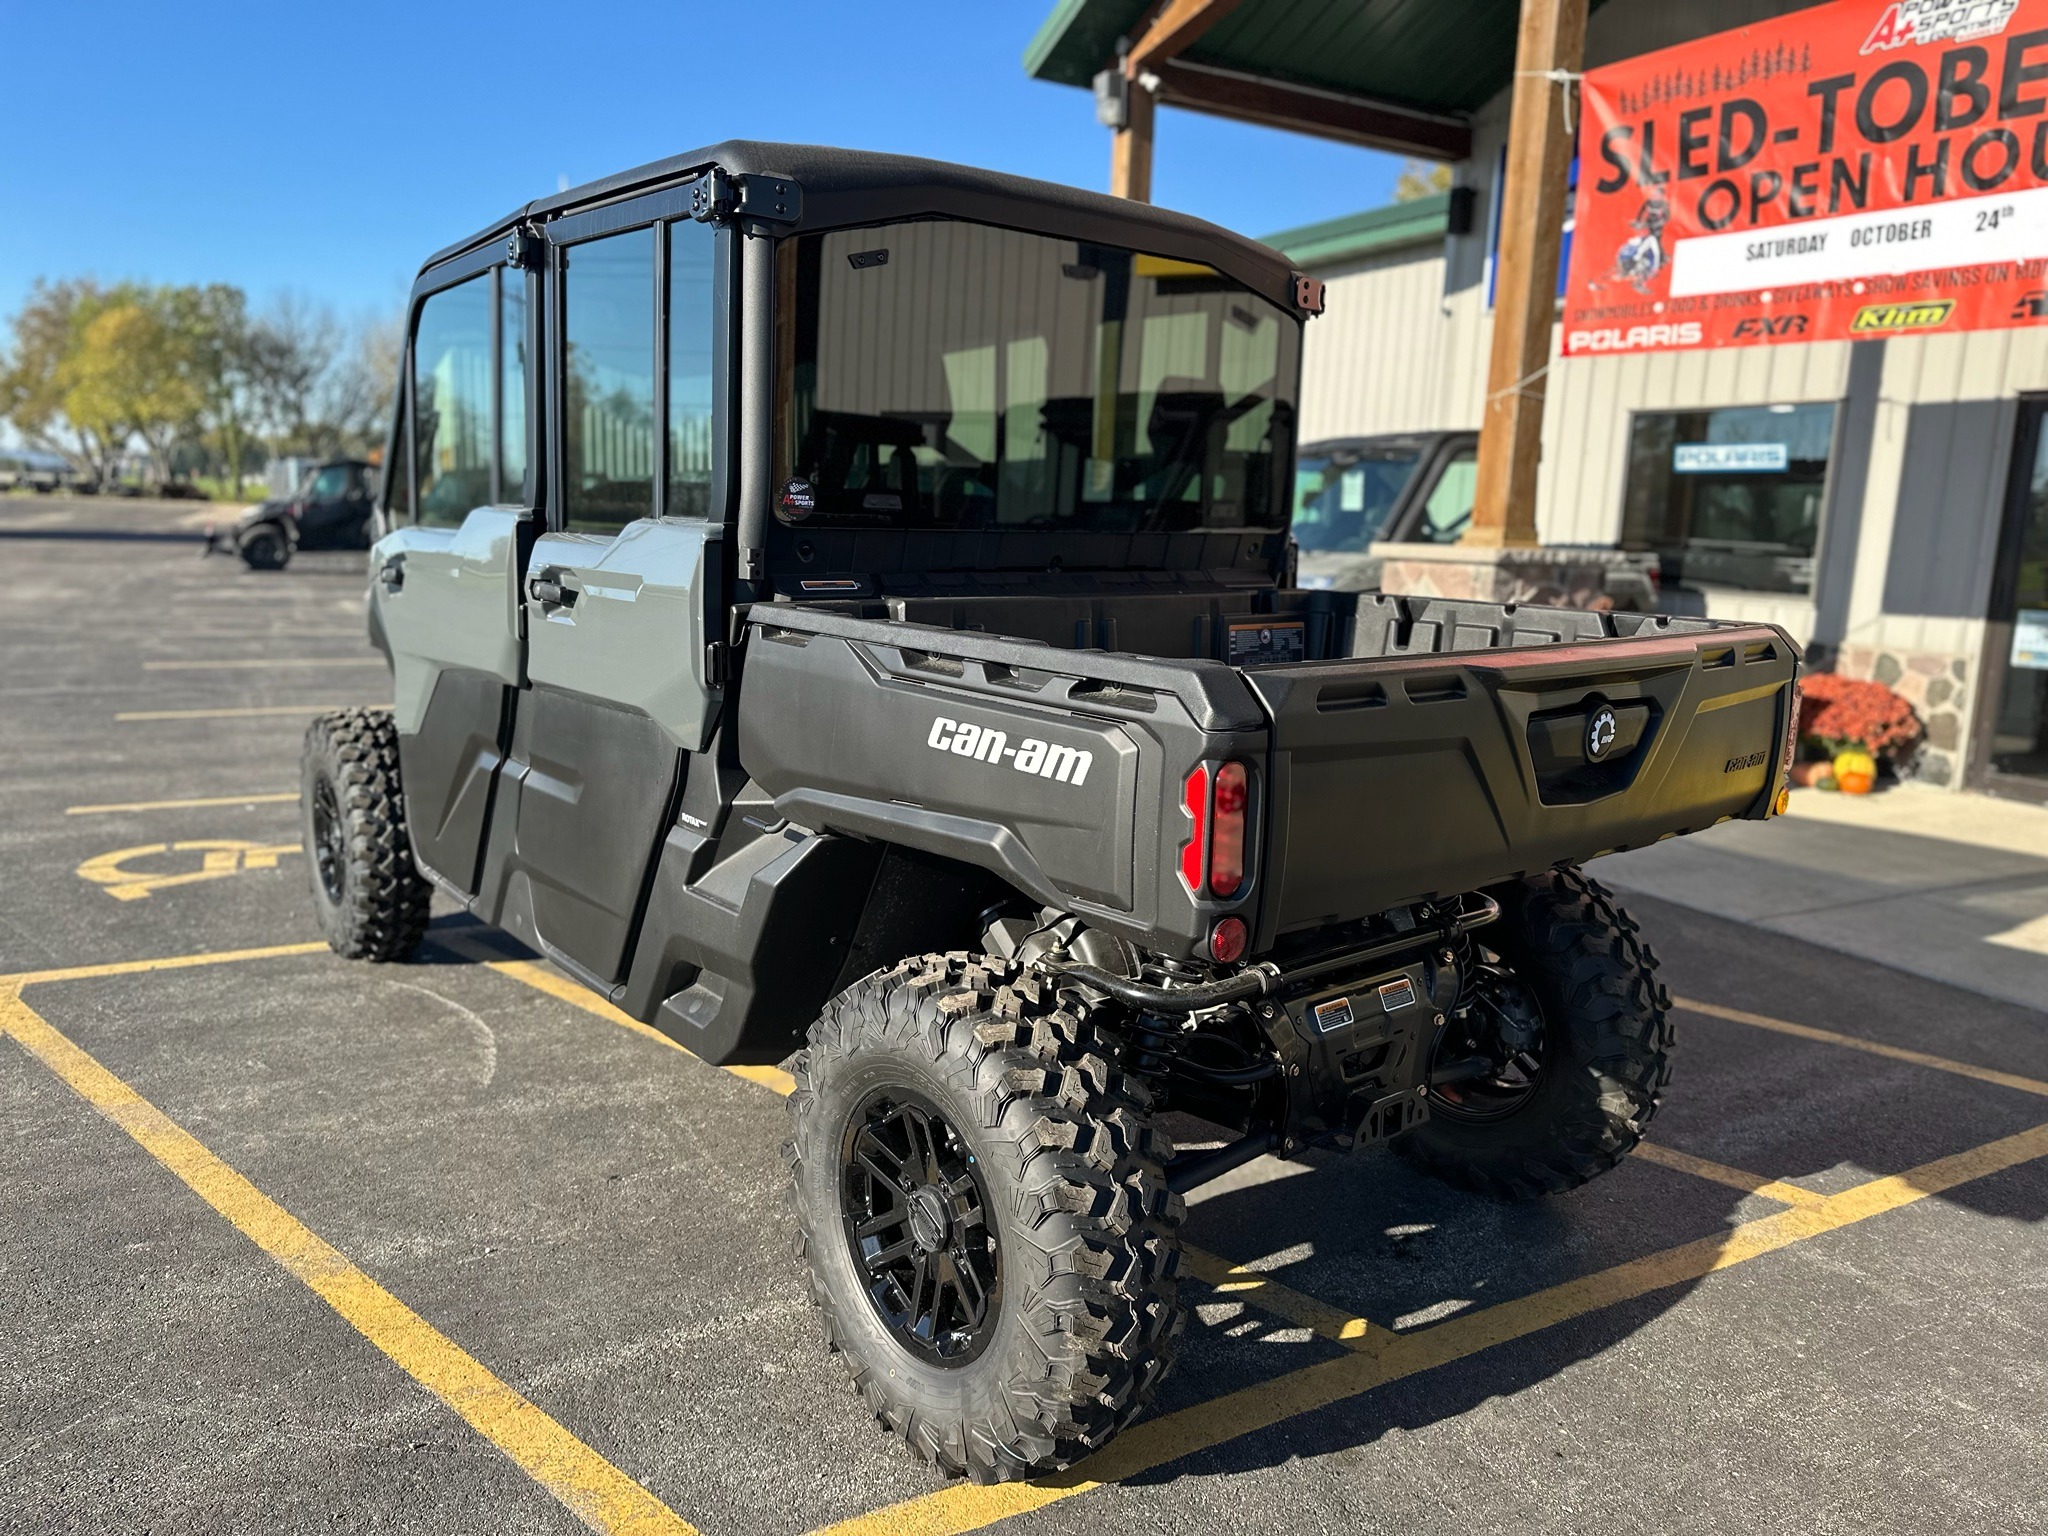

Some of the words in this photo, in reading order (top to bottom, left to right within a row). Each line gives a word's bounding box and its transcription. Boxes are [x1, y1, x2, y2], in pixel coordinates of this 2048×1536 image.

[1697, 153, 1871, 231] OPEN
[1745, 233, 1828, 262] SATURDAY
[1850, 219, 1932, 248] OCTOBER
[1975, 204, 2015, 232] 24th
[1865, 275, 1907, 295] SHOW
[1912, 267, 1980, 290] SAVINGS
[1985, 265, 2009, 284] ON
[1568, 322, 1703, 353] POLARIS
[1732, 314, 1809, 338] FXR
[927, 716, 1094, 787] can-am
